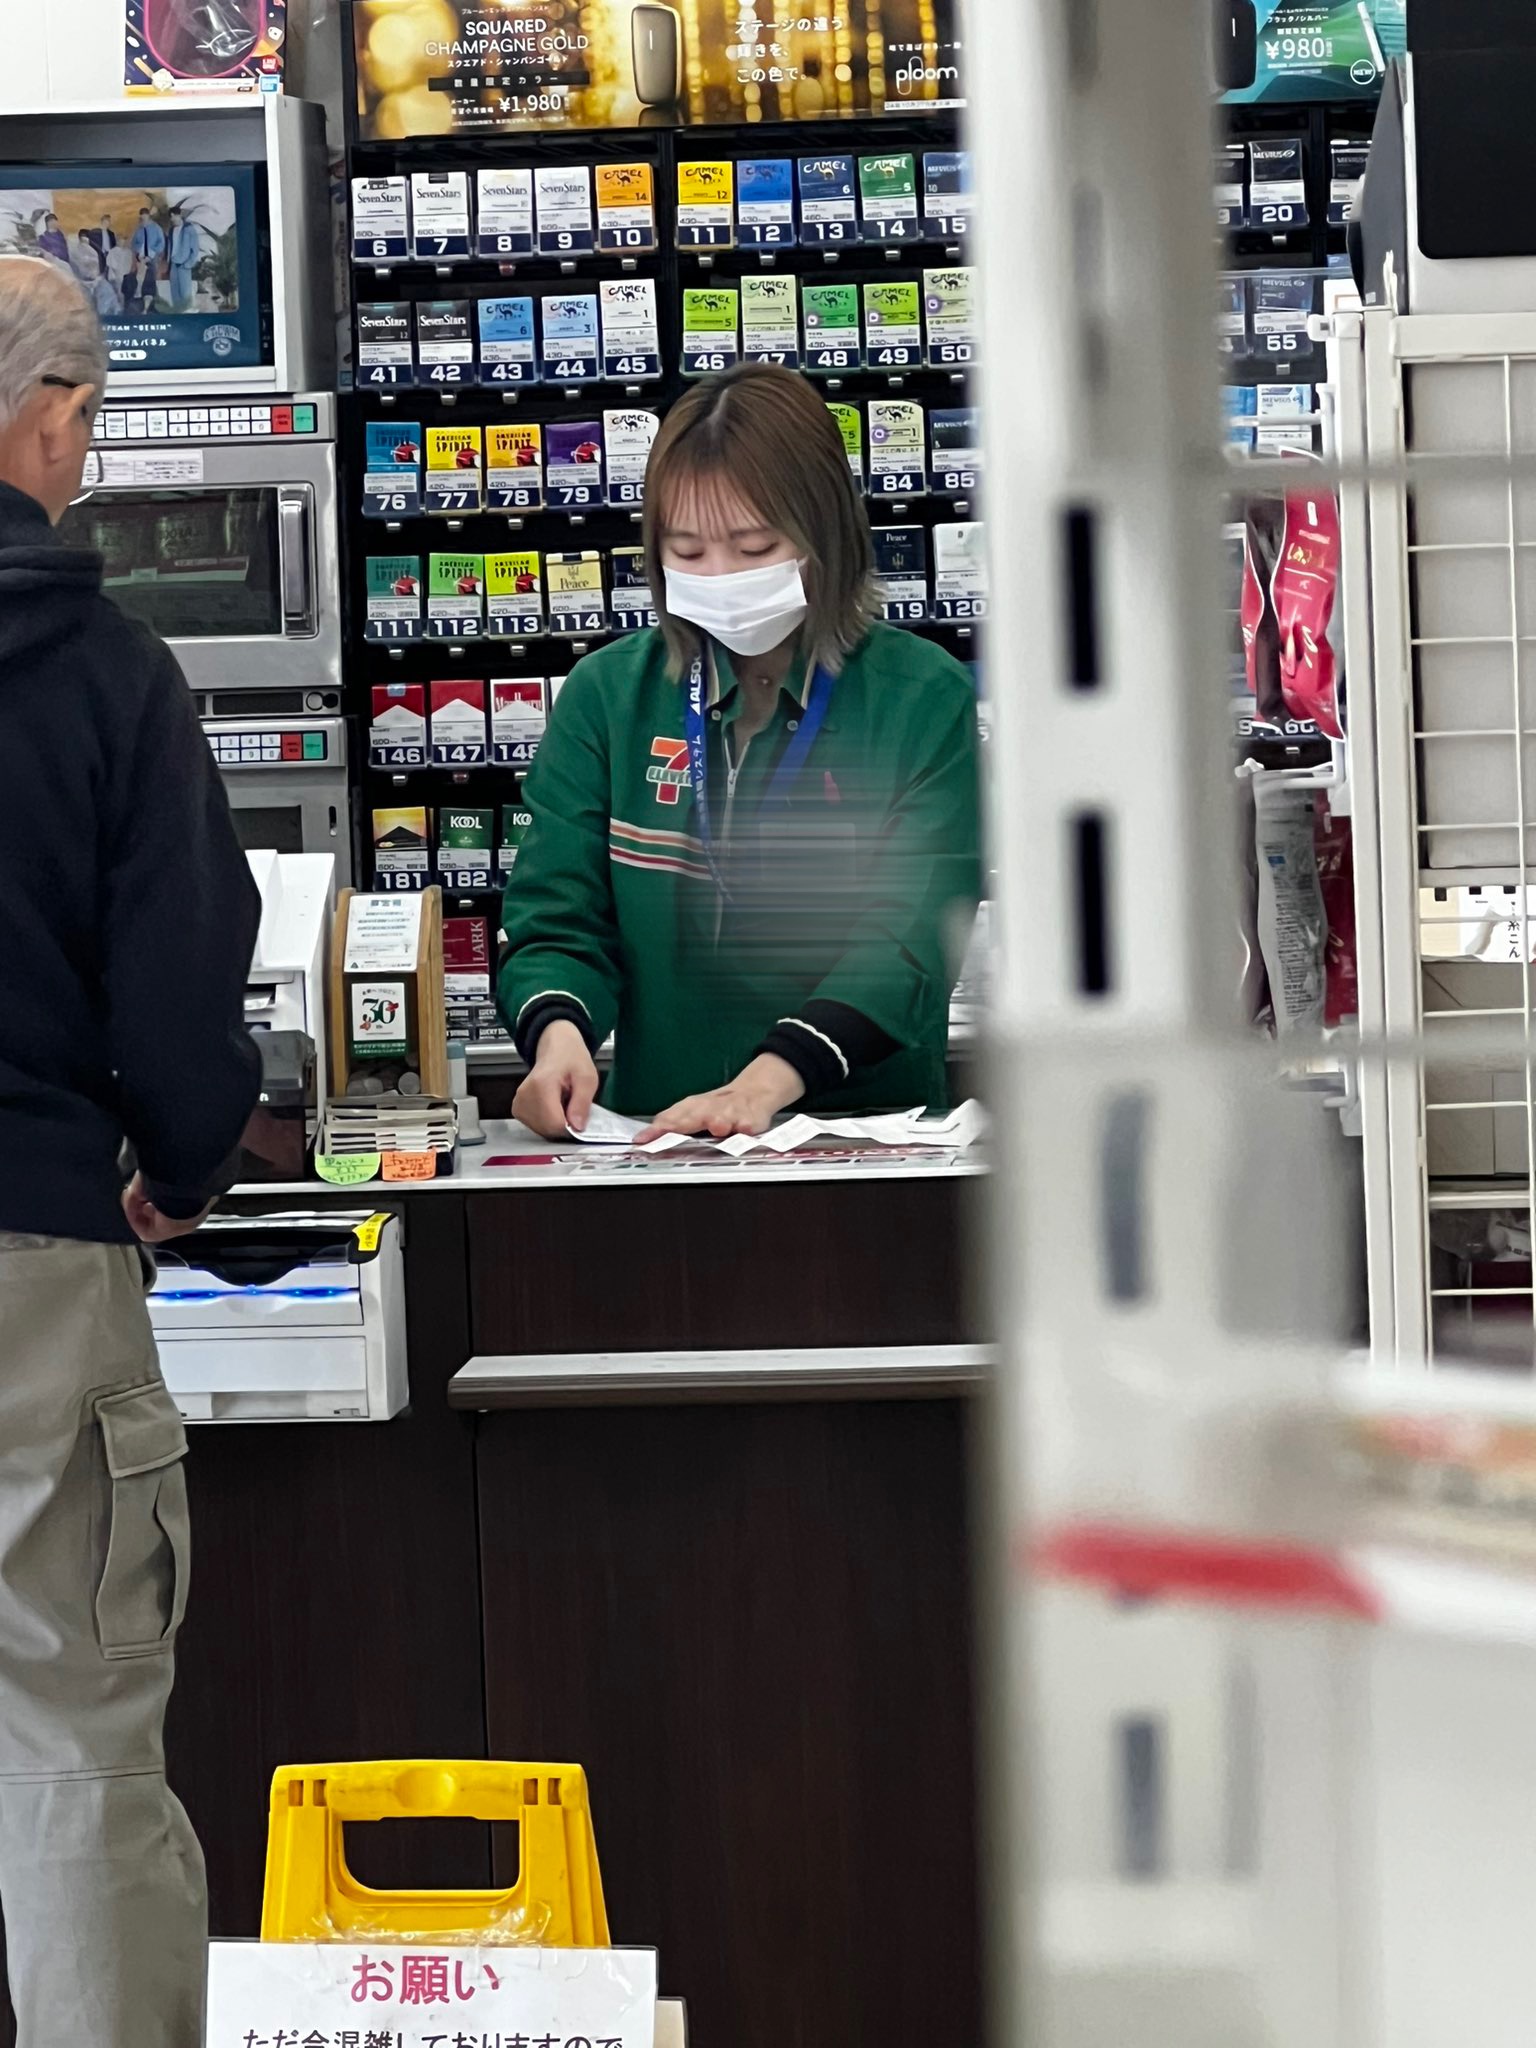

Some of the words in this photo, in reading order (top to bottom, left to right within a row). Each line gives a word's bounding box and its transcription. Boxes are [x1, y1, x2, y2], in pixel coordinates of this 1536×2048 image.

[465, 19, 547, 36] SQUARED
[735, 16, 843, 34] ステージの違う
[425, 37, 536, 56] CHAMPAGNE
[541, 35, 589, 51] GOLD
[1265, 37, 1325, 59] ¥980
[737, 67, 807, 83] この色で。
[896, 56, 958, 95] ploom
[499, 94, 561, 114] ¥1,980
[685, 167, 724, 176] CAMEL
[803, 160, 847, 173] CAMEL
[864, 157, 907, 171] CAMEL
[604, 169, 643, 180] CAMEL
[842, 185, 850, 194] 6
[904, 182, 912, 191] 5
[717, 191, 728, 199] 12
[1262, 205, 1293, 223] 20
[752, 225, 780, 242] 12
[815, 223, 844, 240] 13
[877, 220, 905, 237] 14
[939, 217, 967, 234] 15
[558, 233, 572, 249] 9
[613, 229, 641, 246] 10
[691, 227, 715, 243] 11
[373, 240, 387, 256] 6
[434, 238, 448, 254] 7
[497, 236, 513, 251] 8
[608, 285, 647, 295] CAMEL
[750, 280, 788, 290] CAMEL
[872, 288, 911, 298] CAMEL
[692, 294, 730, 304] CAMEL
[811, 290, 850, 300] CAMEL
[486, 301, 525, 313] CAMEL
[550, 301, 589, 311] CAMEL
[725, 318, 731, 327] 5
[908, 311, 916, 320] 5
[520, 326, 527, 334] 6
[584, 324, 591, 333] 3
[1267, 334, 1297, 351] 55
[817, 350, 847, 367] 48
[878, 348, 909, 364] 49
[941, 345, 971, 361] 50
[555, 360, 586, 376] 44
[616, 356, 647, 373] 45
[694, 354, 724, 370] 46
[370, 366, 397, 383] 41
[430, 365, 461, 381] 42
[492, 364, 522, 380] 43
[876, 405, 914, 416] CAMEL
[612, 414, 649, 425] CAMEL
[436, 441, 471, 452] SPIRIT
[496, 439, 531, 450] SPIRIT
[883, 475, 913, 491] 84
[945, 473, 976, 488] 85
[376, 494, 406, 511] 76
[438, 492, 468, 509] 77
[499, 490, 529, 506] 78
[559, 487, 589, 504] 79
[886, 533, 907, 542] Peace
[439, 568, 474, 578] SPIRIT
[495, 566, 530, 578] SPIRIT
[560, 579, 589, 589] Peace
[882, 602, 923, 619] 119
[943, 601, 986, 618] 120
[374, 621, 412, 637] 111
[434, 619, 478, 636] 112
[495, 617, 538, 634] 113
[556, 613, 600, 631] 114
[378, 749, 420, 764] 146
[438, 745, 481, 762] 147
[450, 815, 483, 829] KOOL
[382, 873, 422, 889] 181
[444, 871, 487, 887] 182
[470, 921, 485, 961] LARK
[362, 998, 396, 1024] 30
[350, 1954, 501, 2005] お願い
